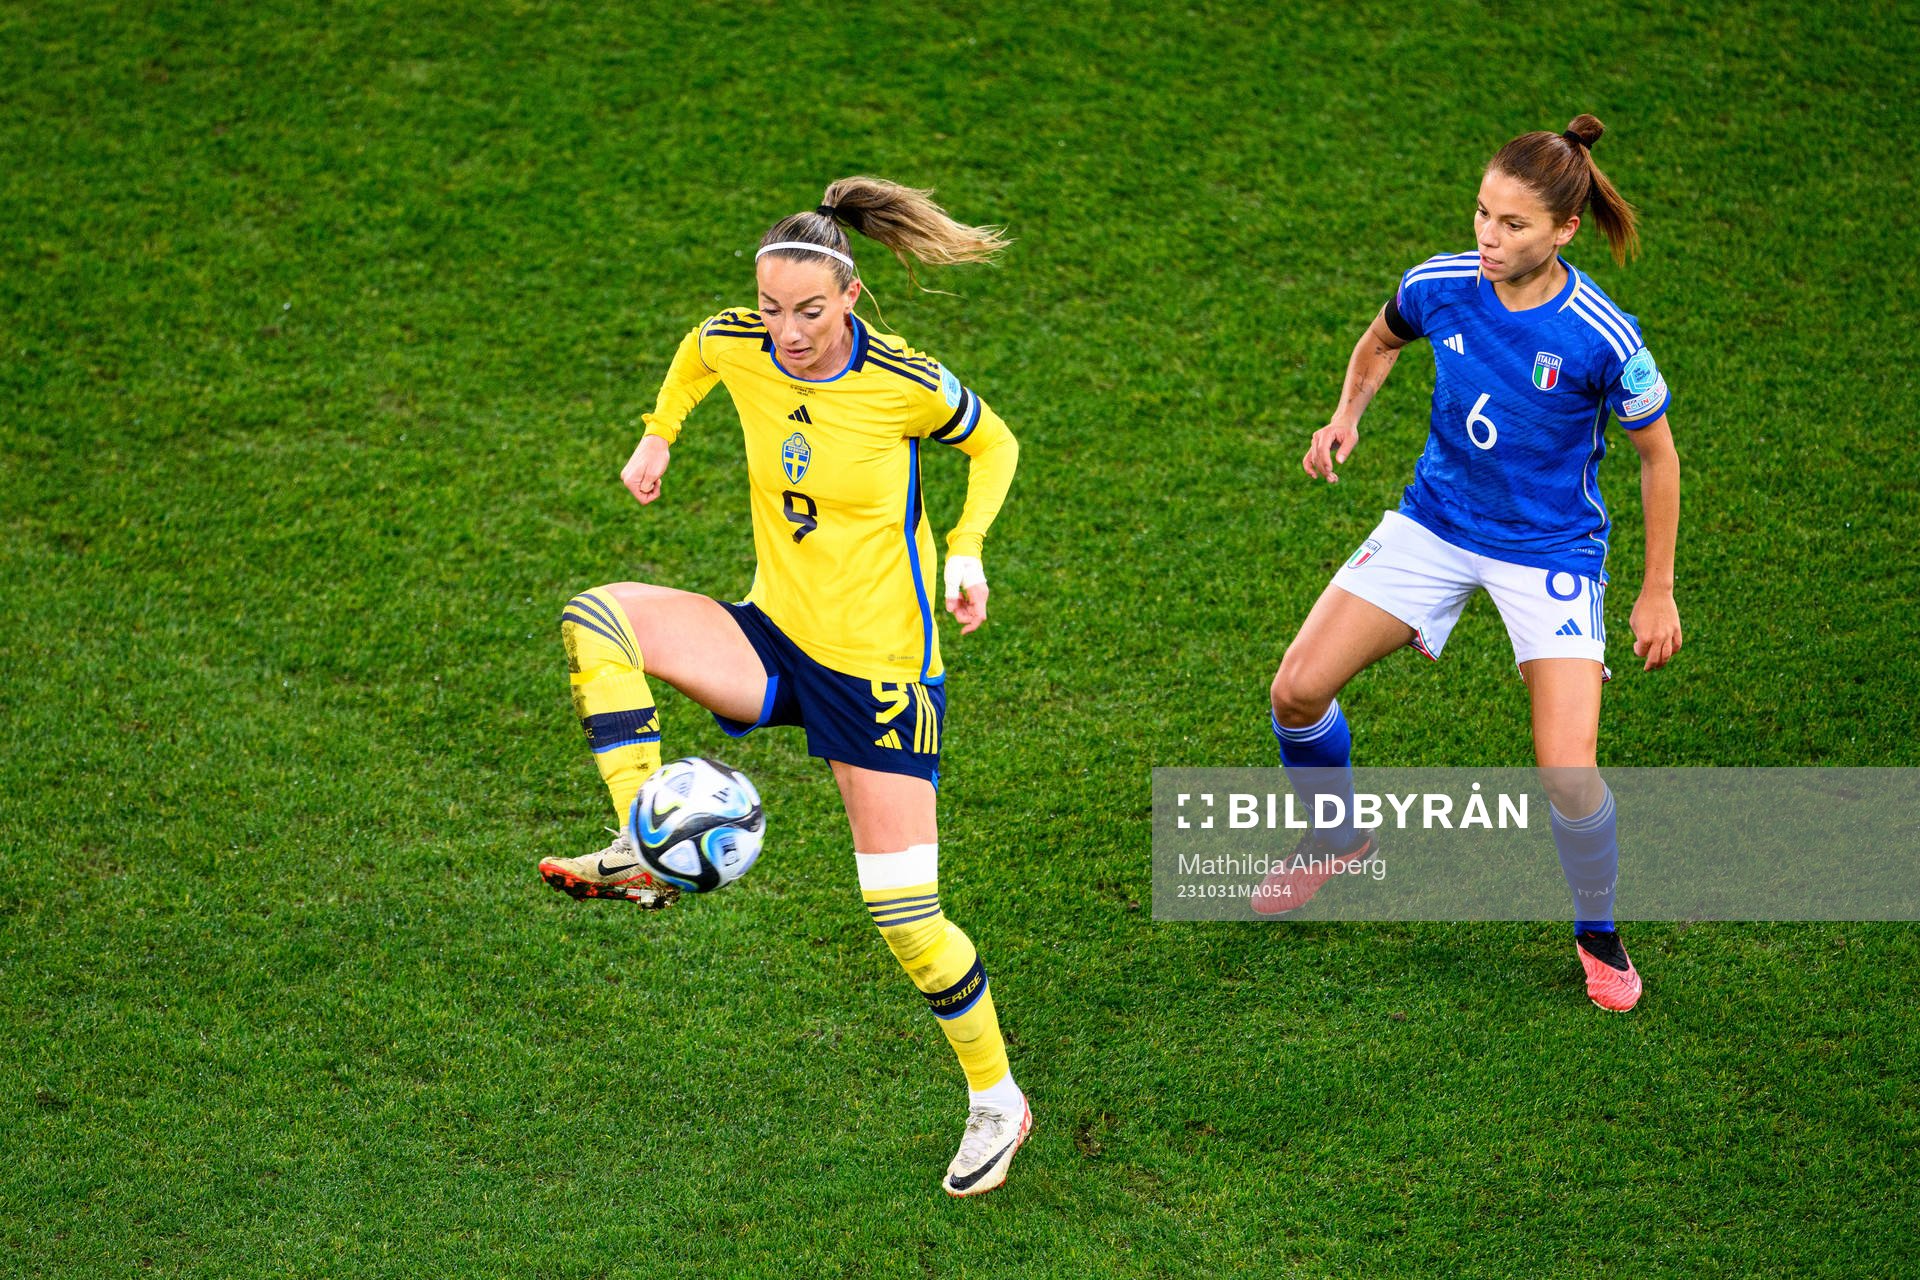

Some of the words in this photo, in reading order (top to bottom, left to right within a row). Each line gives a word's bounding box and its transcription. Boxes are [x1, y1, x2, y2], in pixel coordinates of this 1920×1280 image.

[1537, 354, 1560, 367] ITALIA
[1466, 392, 1498, 450] 6
[782, 489, 818, 544] 9
[871, 679, 910, 724] 9
